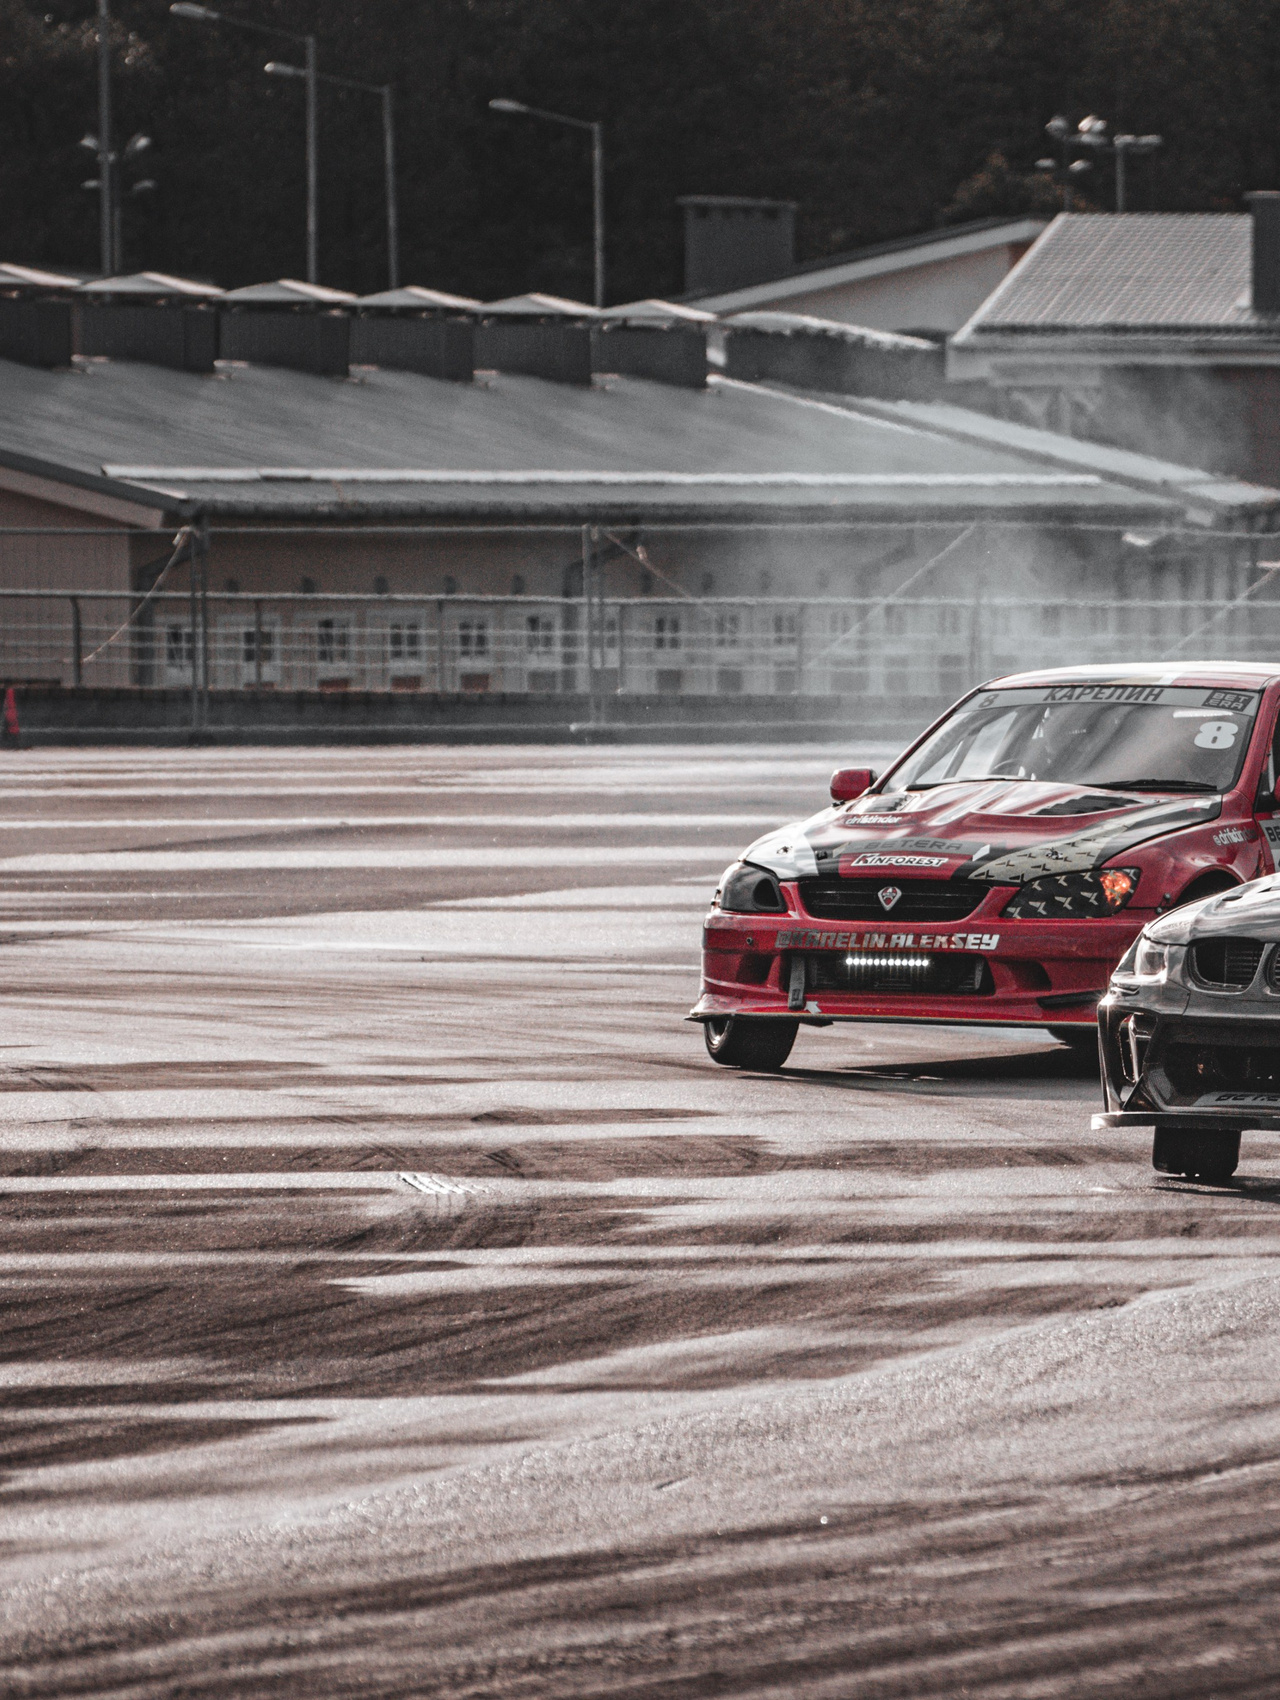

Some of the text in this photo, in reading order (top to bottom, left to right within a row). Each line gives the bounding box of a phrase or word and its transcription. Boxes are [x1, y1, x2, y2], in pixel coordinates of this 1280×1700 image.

[978, 687, 1164, 709] 8 КАРЕЛИН
[1211, 692, 1249, 703] BET
[1194, 721, 1239, 749] 8
[852, 853, 947, 867] KINFOREST
